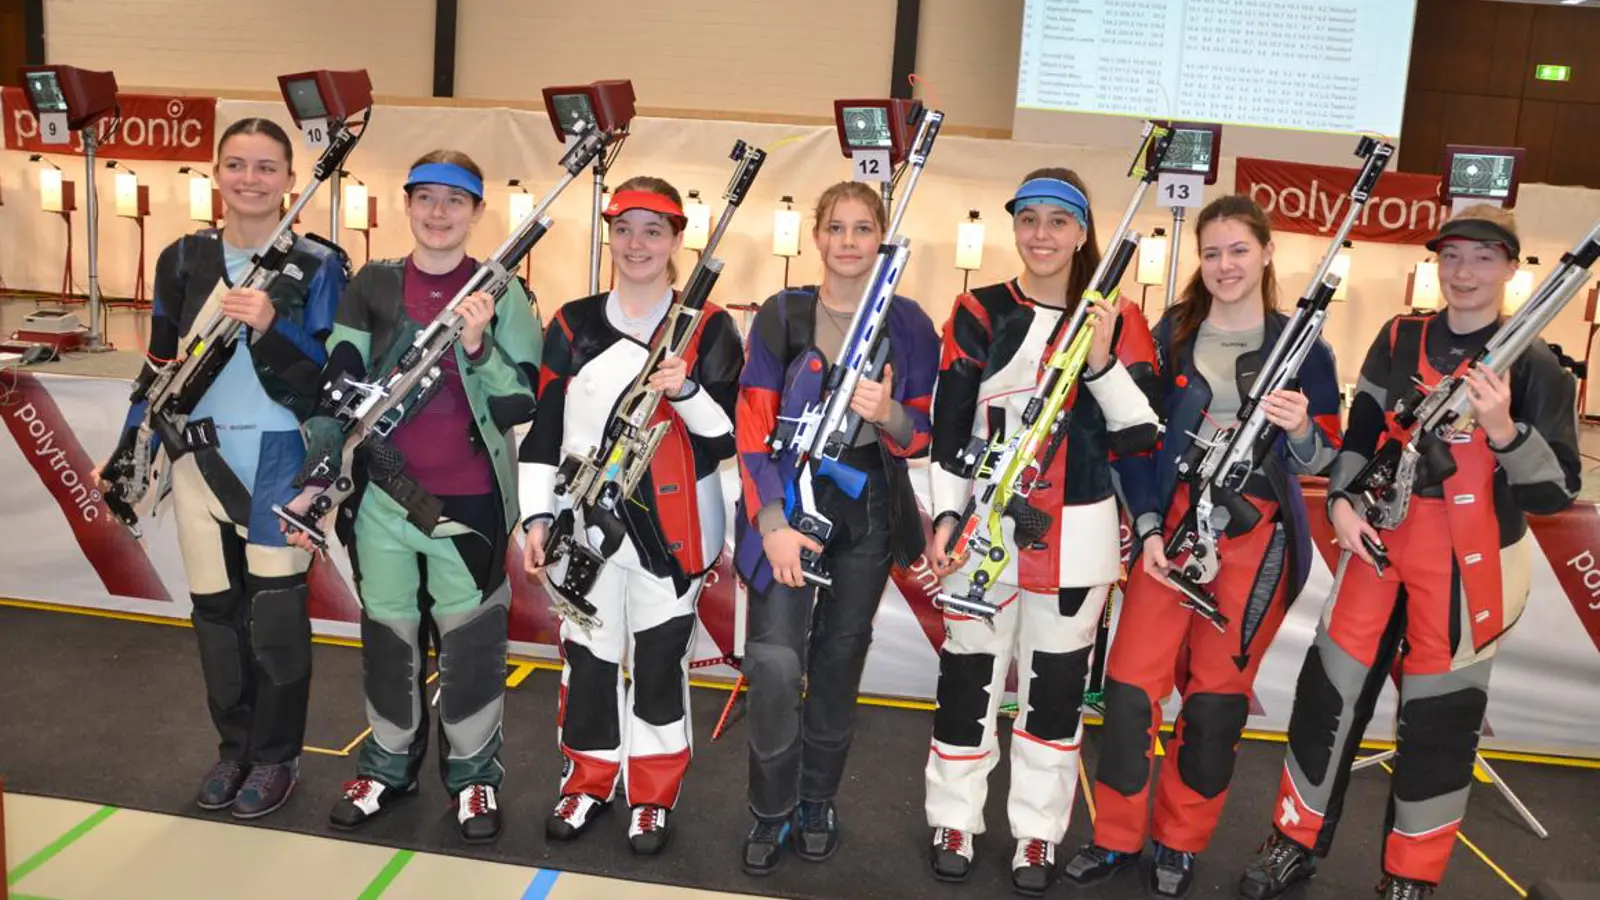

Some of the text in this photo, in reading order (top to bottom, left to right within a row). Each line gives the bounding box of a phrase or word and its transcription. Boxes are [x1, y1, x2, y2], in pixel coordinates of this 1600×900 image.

[49, 122, 56, 136] 9
[308, 128, 322, 142] 10
[859, 159, 880, 174] 12
[1165, 183, 1190, 199] 13
[14, 402, 101, 522] polytronic
